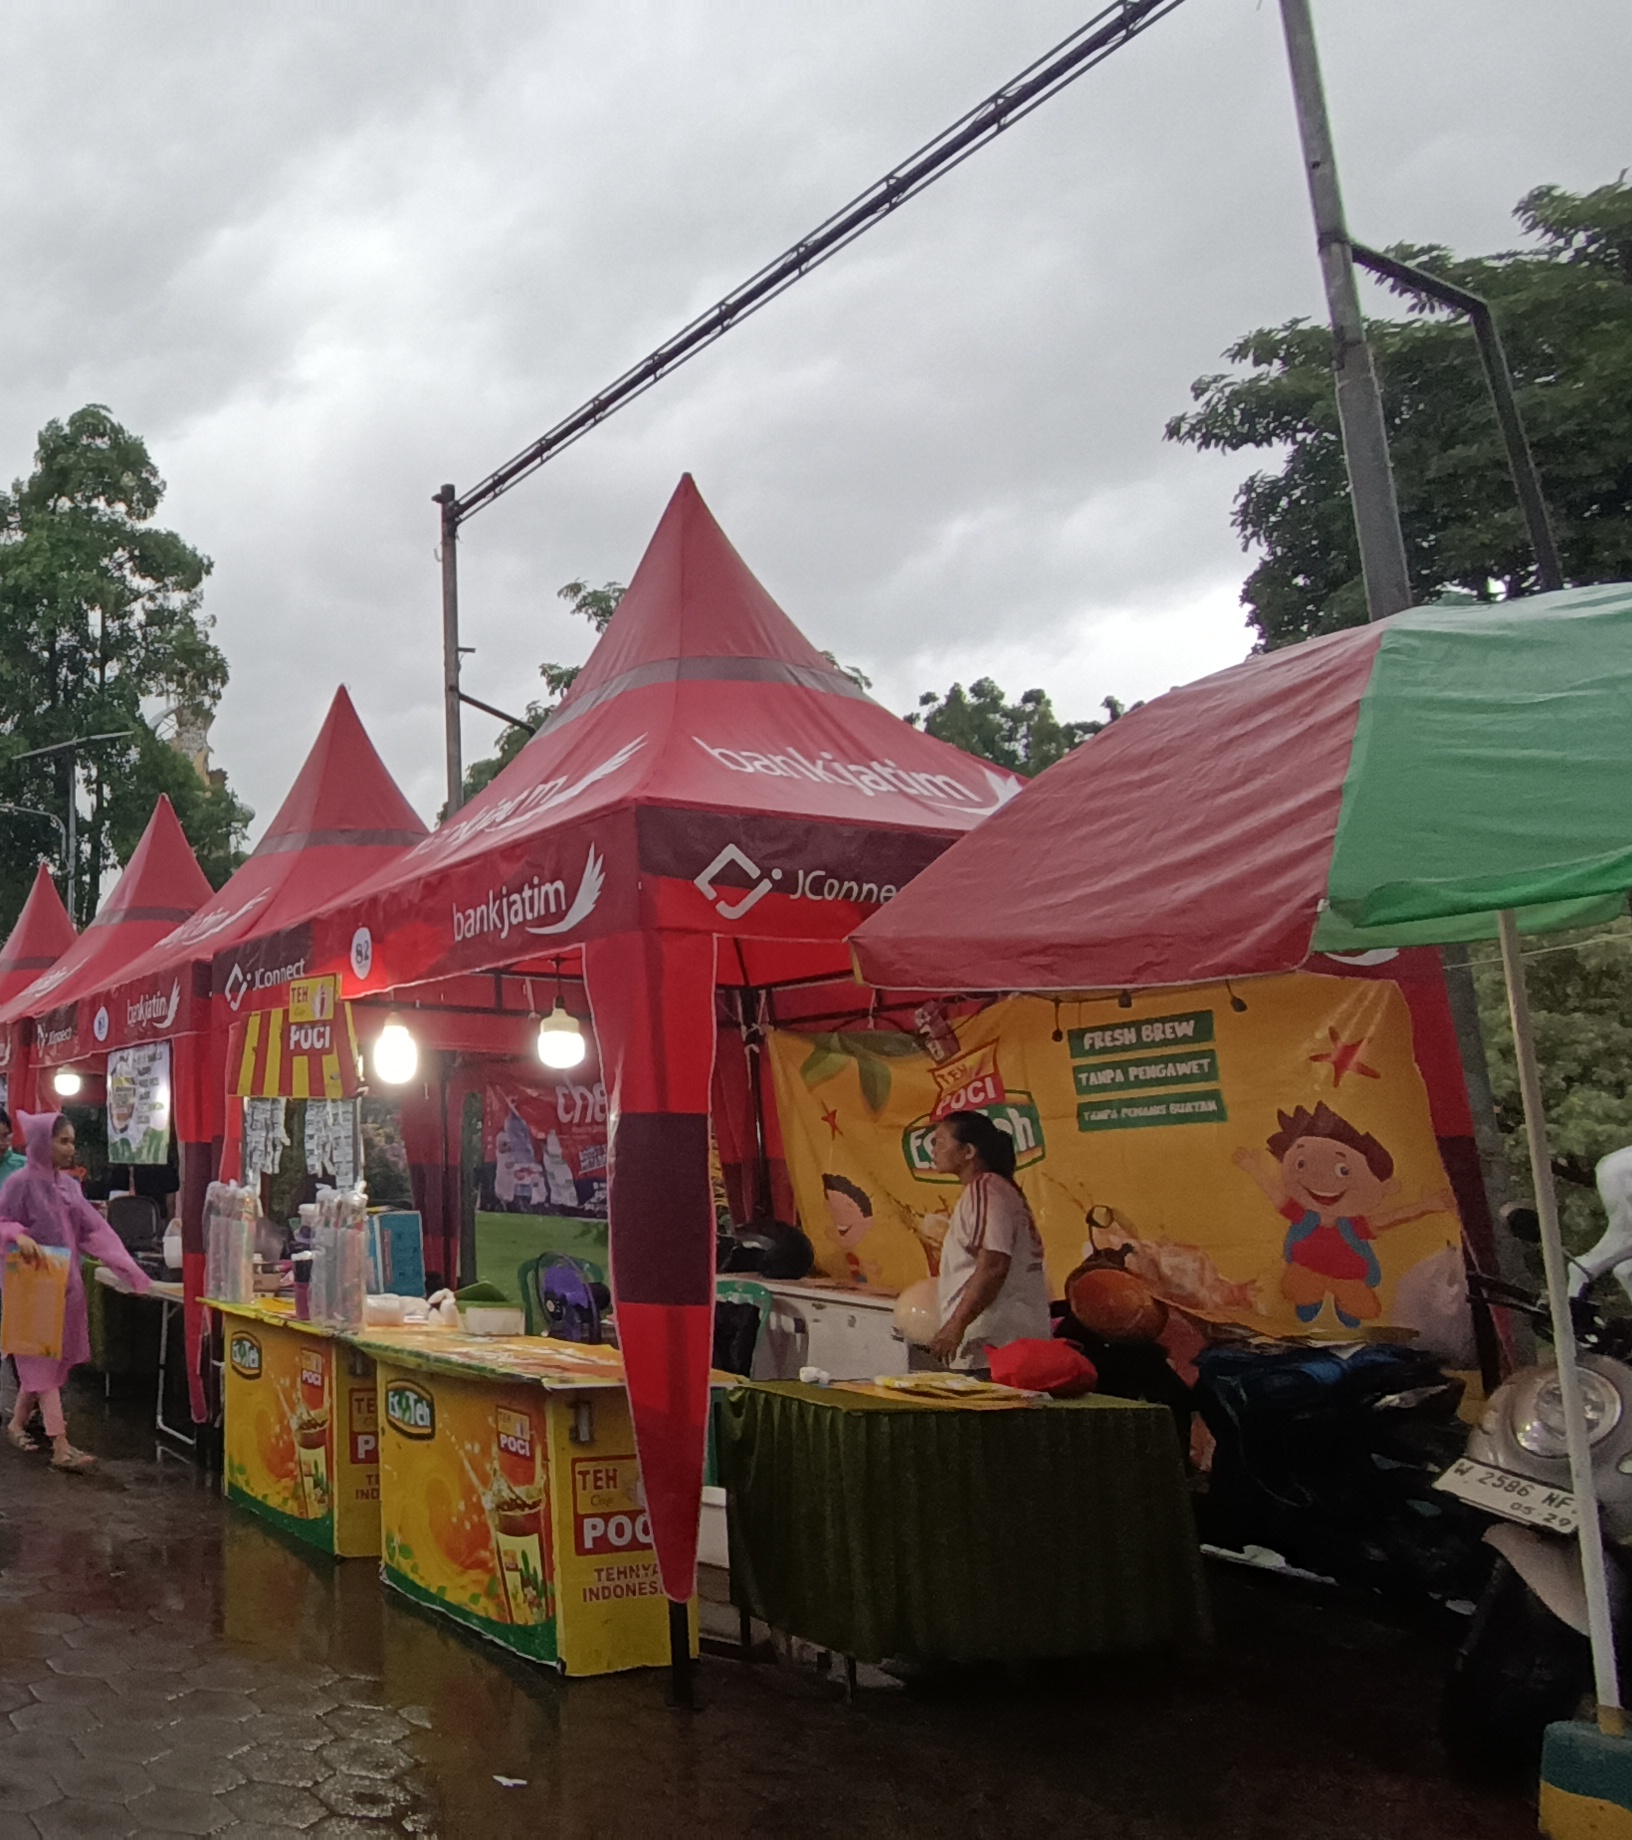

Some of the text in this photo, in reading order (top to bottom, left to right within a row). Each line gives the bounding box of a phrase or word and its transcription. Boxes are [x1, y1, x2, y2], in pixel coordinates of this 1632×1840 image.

[692, 736, 980, 802] bankjatim
[452, 875, 567, 942] bankjatim
[355, 940, 369, 964] 82
[253, 958, 305, 991] JConnect
[290, 985, 308, 1003] TEH
[289, 1025, 330, 1050] POCI
[1083, 1020, 1195, 1050] FRESH BREW
[937, 1063, 967, 1086] TEH
[1078, 1059, 1211, 1086] TANPA PENGAWET
[936, 1077, 996, 1115] POCI
[302, 1370, 322, 1386] POCI
[388, 1391, 430, 1427] Es Teh
[499, 1433, 530, 1457] POCI
[577, 1468, 617, 1491] TEH
[1454, 1462, 1472, 1477] W
[1478, 1471, 1536, 1497] 2586
[582, 1581, 664, 1602] INDONES
